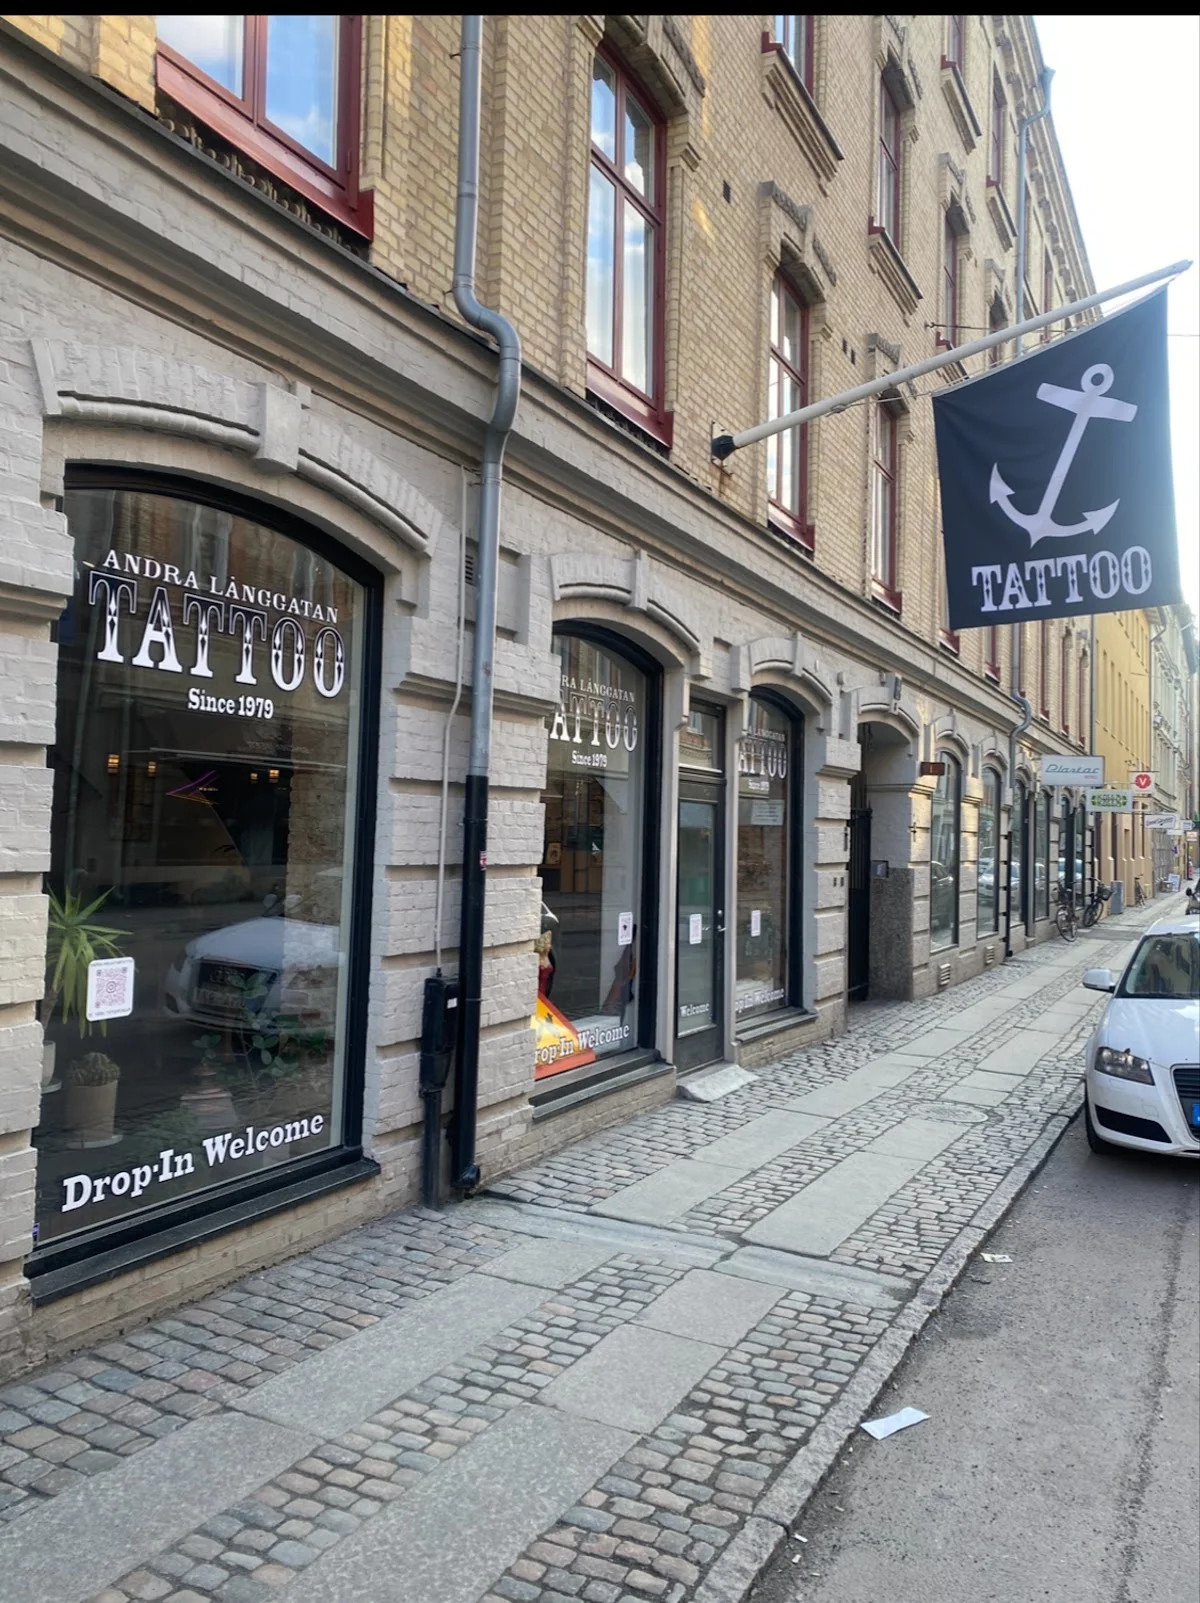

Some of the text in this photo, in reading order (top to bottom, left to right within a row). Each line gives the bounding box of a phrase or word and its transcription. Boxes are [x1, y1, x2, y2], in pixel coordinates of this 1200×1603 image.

[103, 549, 339, 624] ANDRA LÅNGGATAN
[971, 546, 1152, 612] TATTOO
[88, 570, 345, 698] TATTOO
[188, 687, 274, 719] Since 1979
[580, 678, 635, 703] LÅNGGATAN
[550, 689, 638, 752] ATTOO
[572, 750, 608, 768] Since 1979
[738, 739, 787, 779] ATTOO
[577, 1023, 630, 1050] Welcome
[202, 1114, 324, 1167] Welcome
